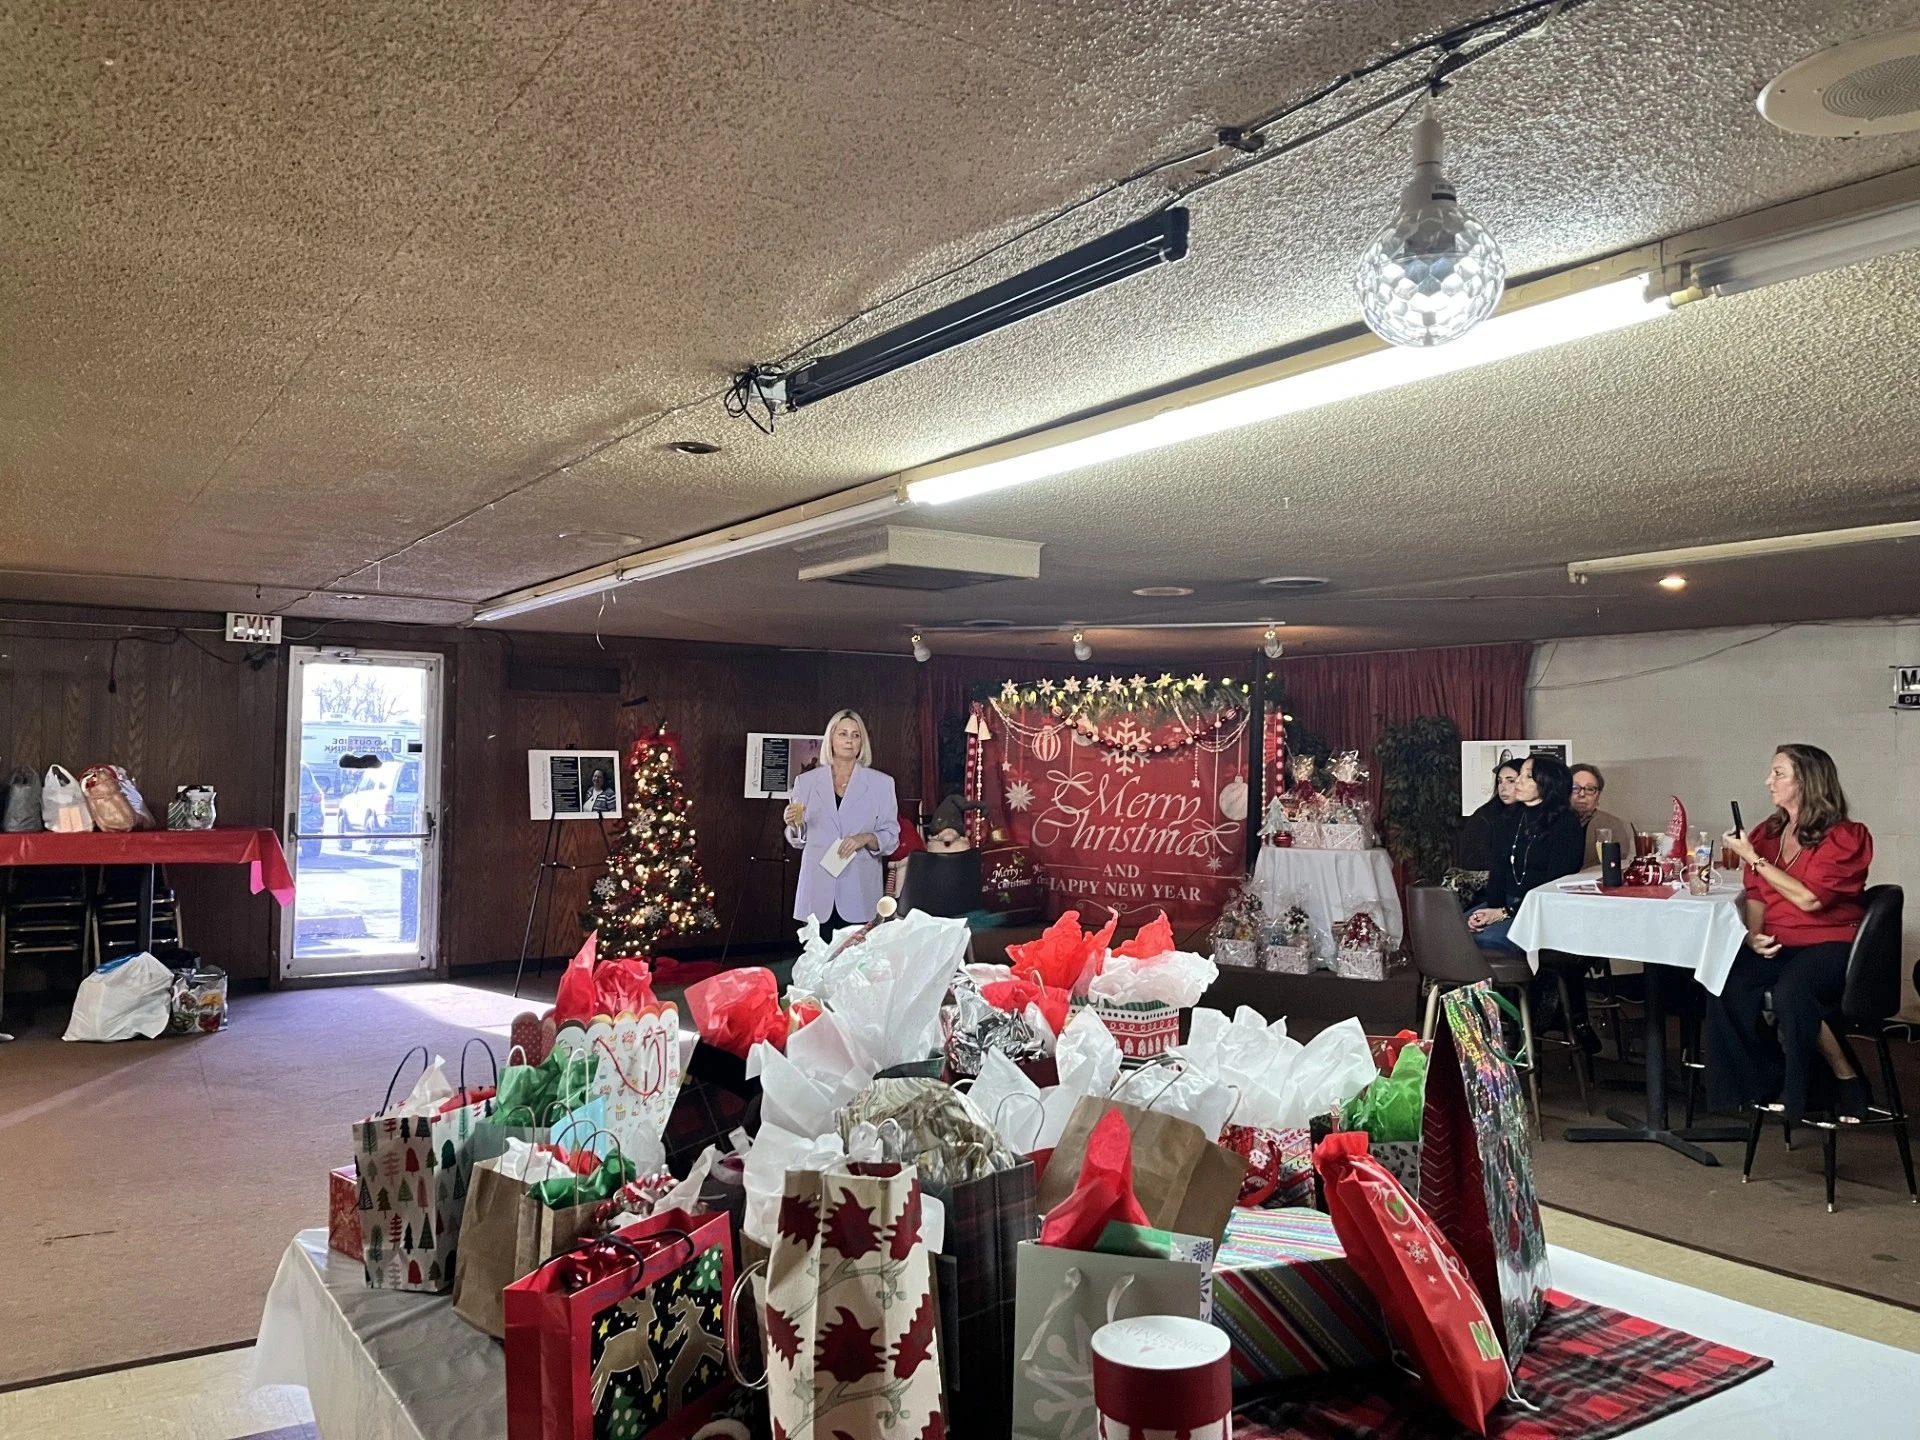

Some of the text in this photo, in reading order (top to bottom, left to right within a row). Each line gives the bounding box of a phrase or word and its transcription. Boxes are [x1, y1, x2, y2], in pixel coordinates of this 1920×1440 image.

[233, 615, 274, 641] EXIT
[1054, 773, 1201, 831] Merry
[1032, 806, 1211, 857] Christmas
[992, 866, 1019, 880] Merry
[1102, 863, 1140, 879] AND
[1105, 881, 1146, 897] NEW
[1152, 884, 1201, 901] YEAR
